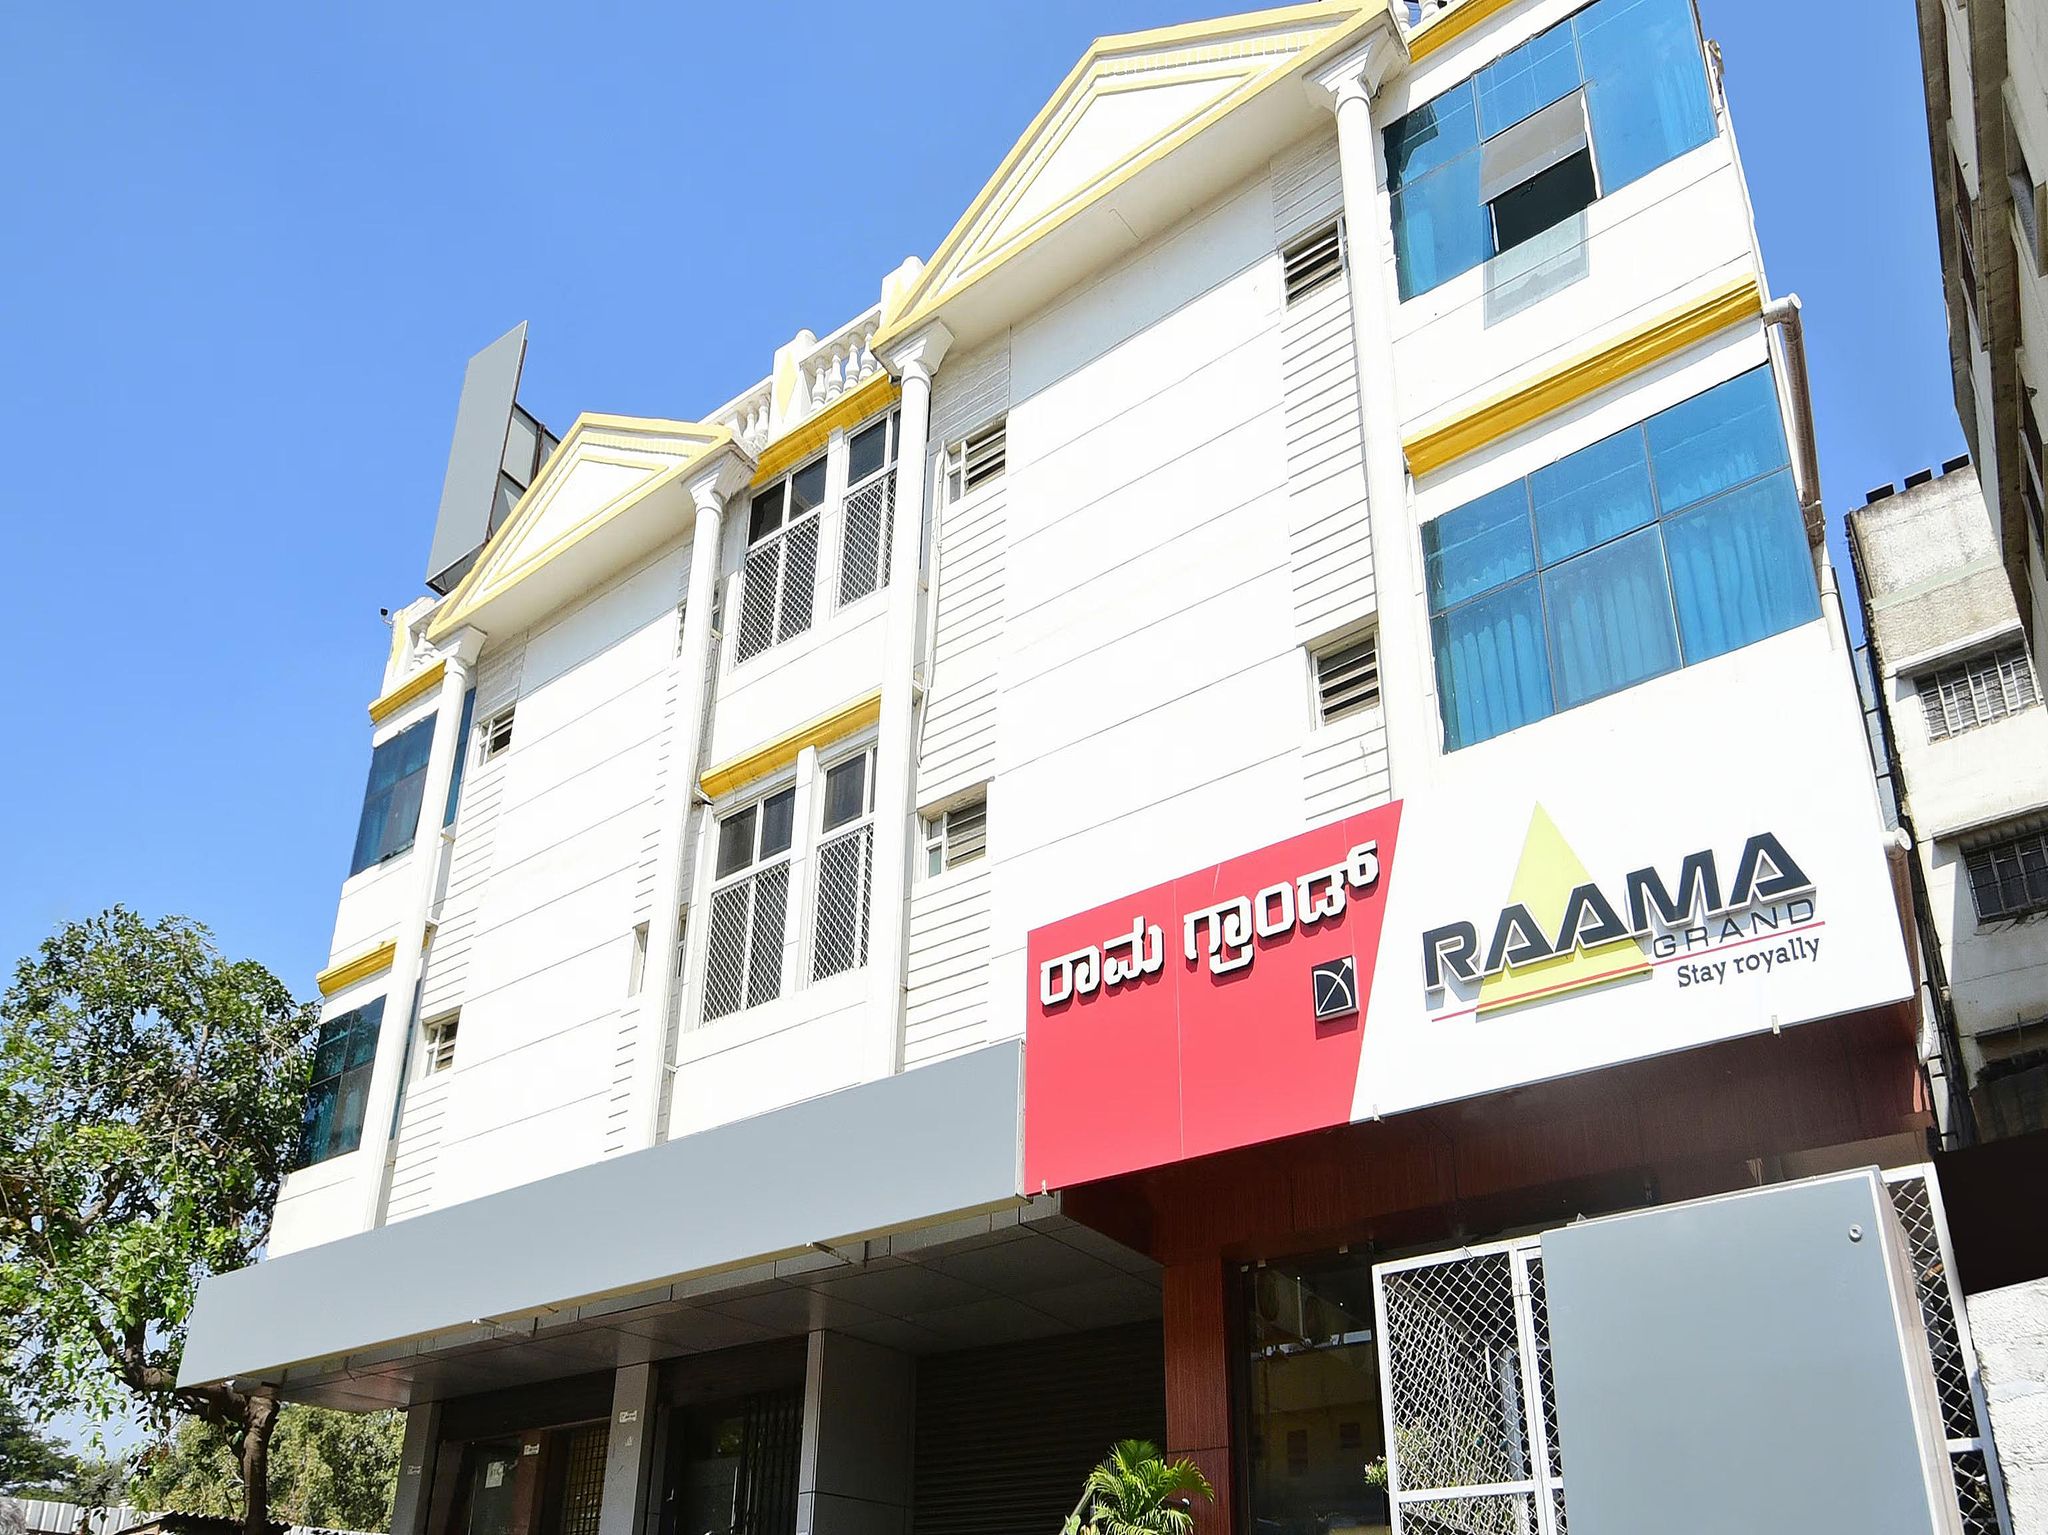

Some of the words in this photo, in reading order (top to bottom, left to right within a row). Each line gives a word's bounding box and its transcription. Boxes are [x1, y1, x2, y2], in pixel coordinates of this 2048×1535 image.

[1422, 832, 1816, 990] RAAMA
[1653, 898, 1815, 959] GRAND
[1039, 915, 1165, 1006] ರಾಮ
[1677, 957, 1727, 988] Stay
[1733, 933, 1821, 974] royally
